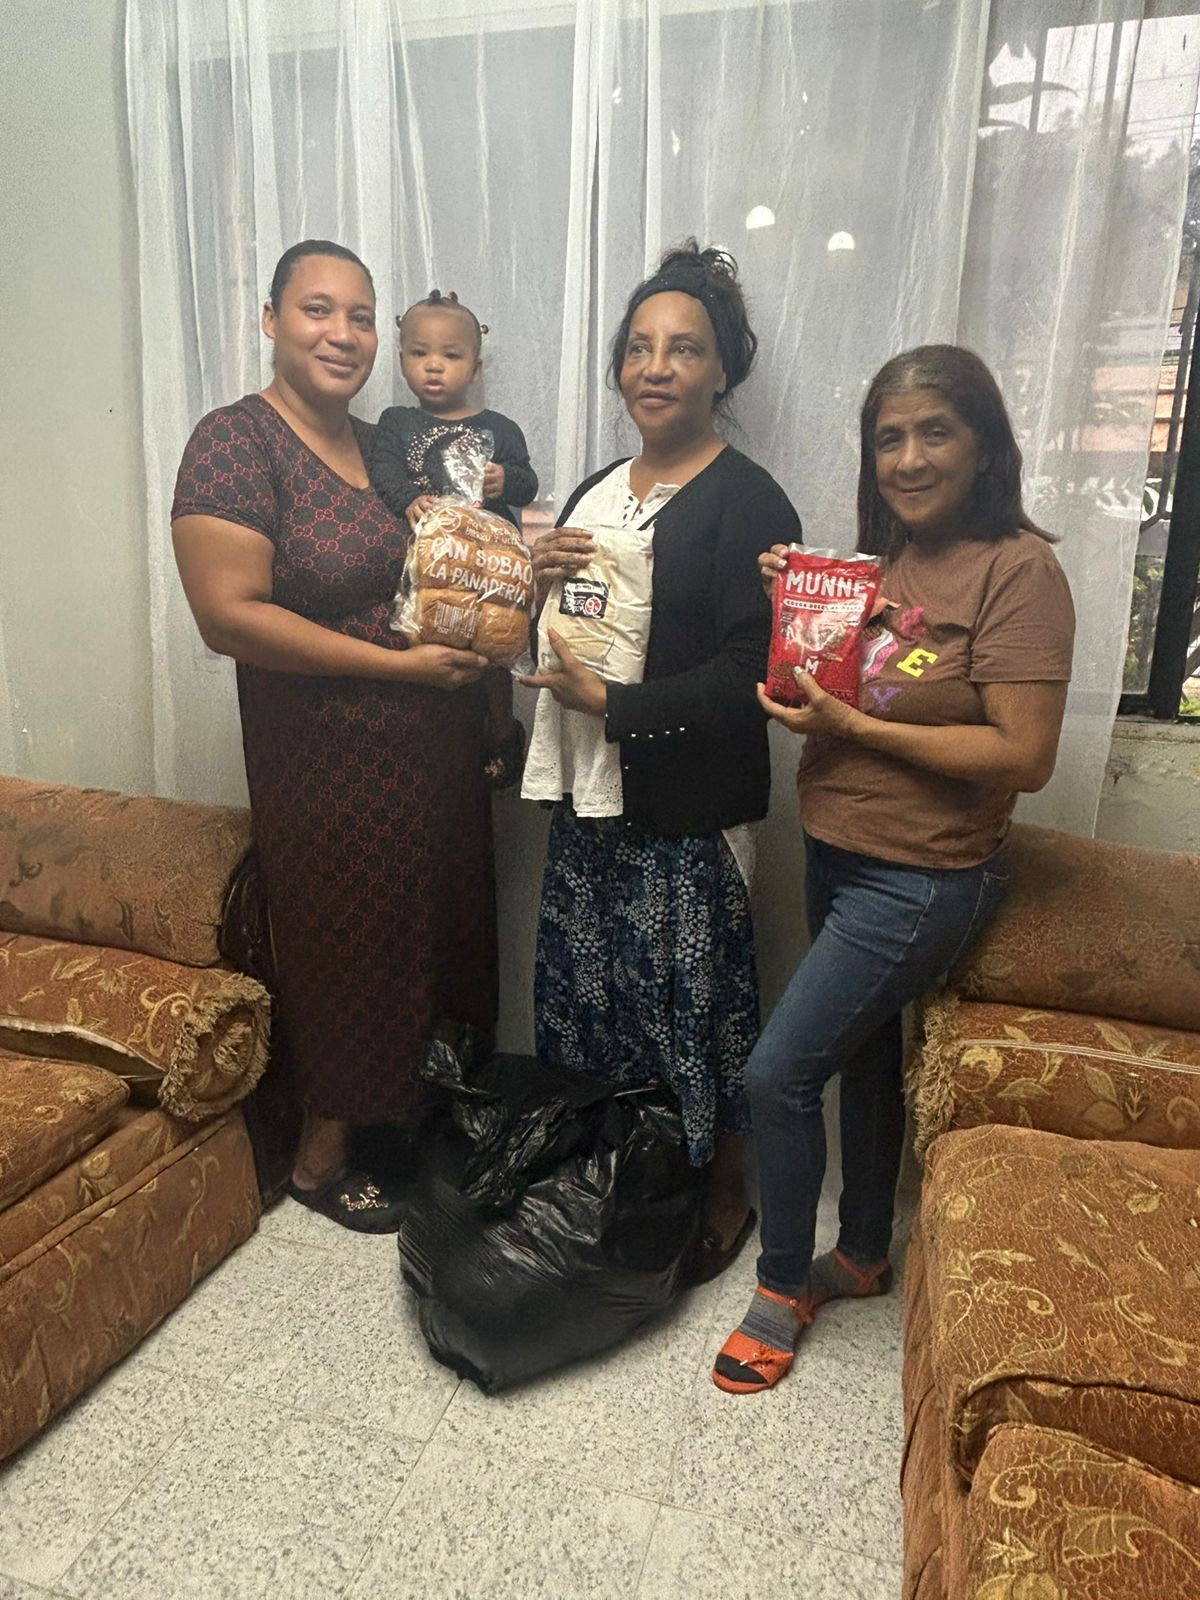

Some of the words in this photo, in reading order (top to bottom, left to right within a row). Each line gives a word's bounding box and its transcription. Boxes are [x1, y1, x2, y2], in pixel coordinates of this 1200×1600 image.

[429, 563, 446, 580] LA
[431, 535, 470, 561] PAN
[475, 549, 533, 585] SOBAO
[896, 648, 938, 678] E
